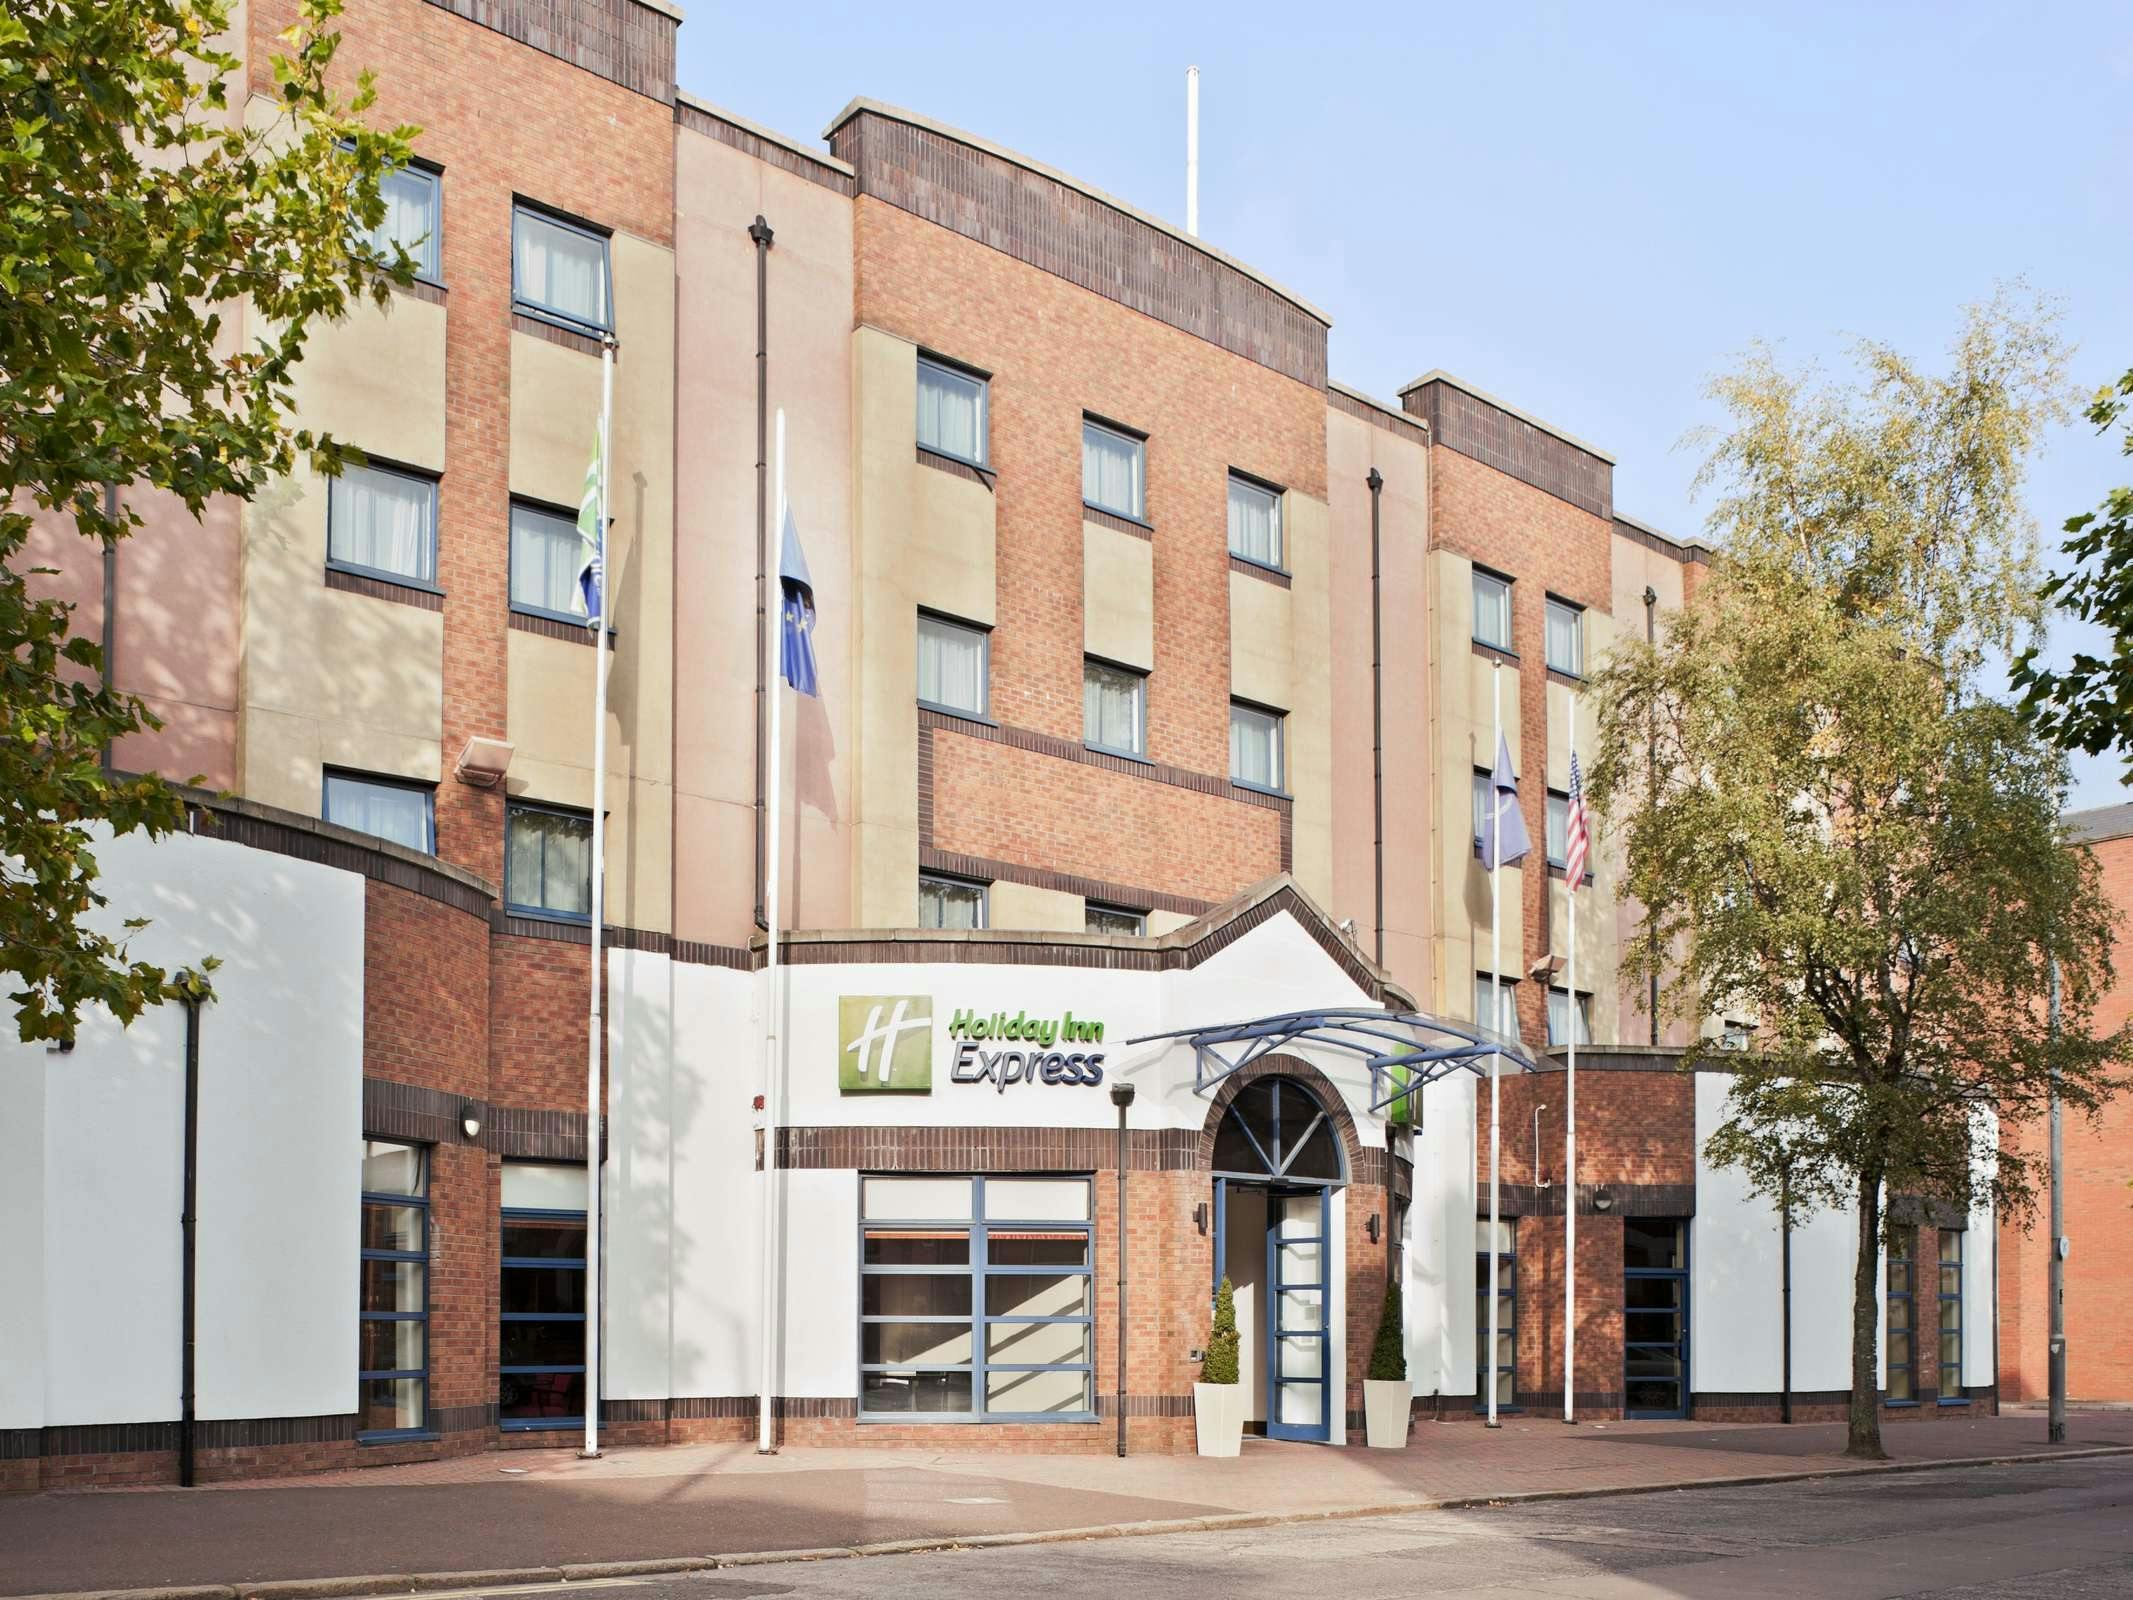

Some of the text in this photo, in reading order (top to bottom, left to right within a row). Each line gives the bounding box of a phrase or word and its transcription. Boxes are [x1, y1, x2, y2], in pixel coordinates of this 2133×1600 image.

[949, 1008, 1104, 1047] Holiday Inn
[950, 1041, 1105, 1094] Express
